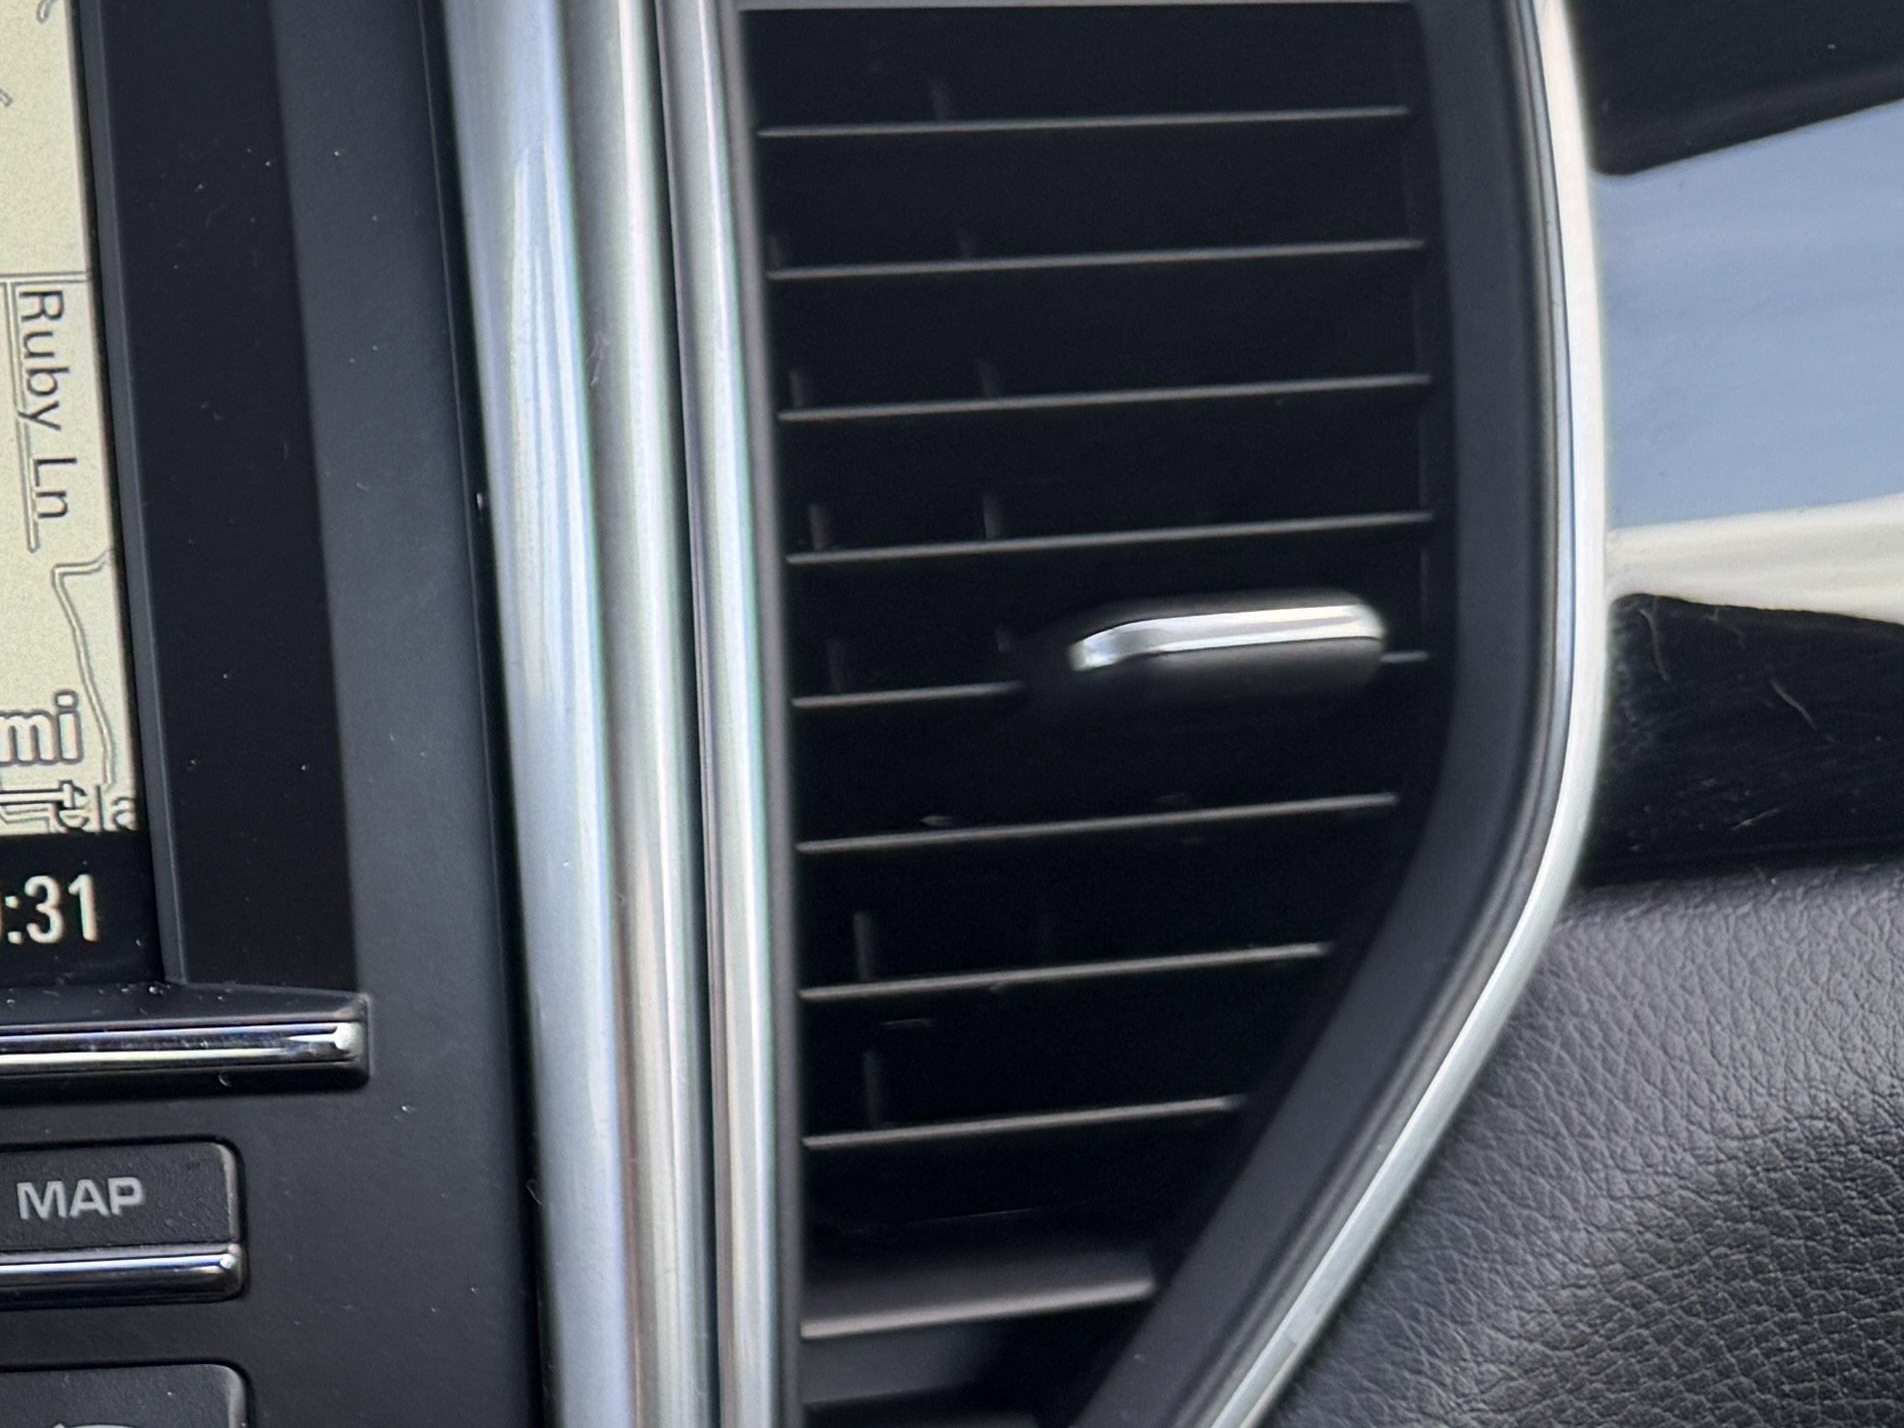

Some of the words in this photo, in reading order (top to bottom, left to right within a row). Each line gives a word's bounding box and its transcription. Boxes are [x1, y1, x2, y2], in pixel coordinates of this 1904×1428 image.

[19, 289, 70, 432] Ruby
[29, 456, 79, 521] Ln
[17, 1176, 146, 1221] MAP
